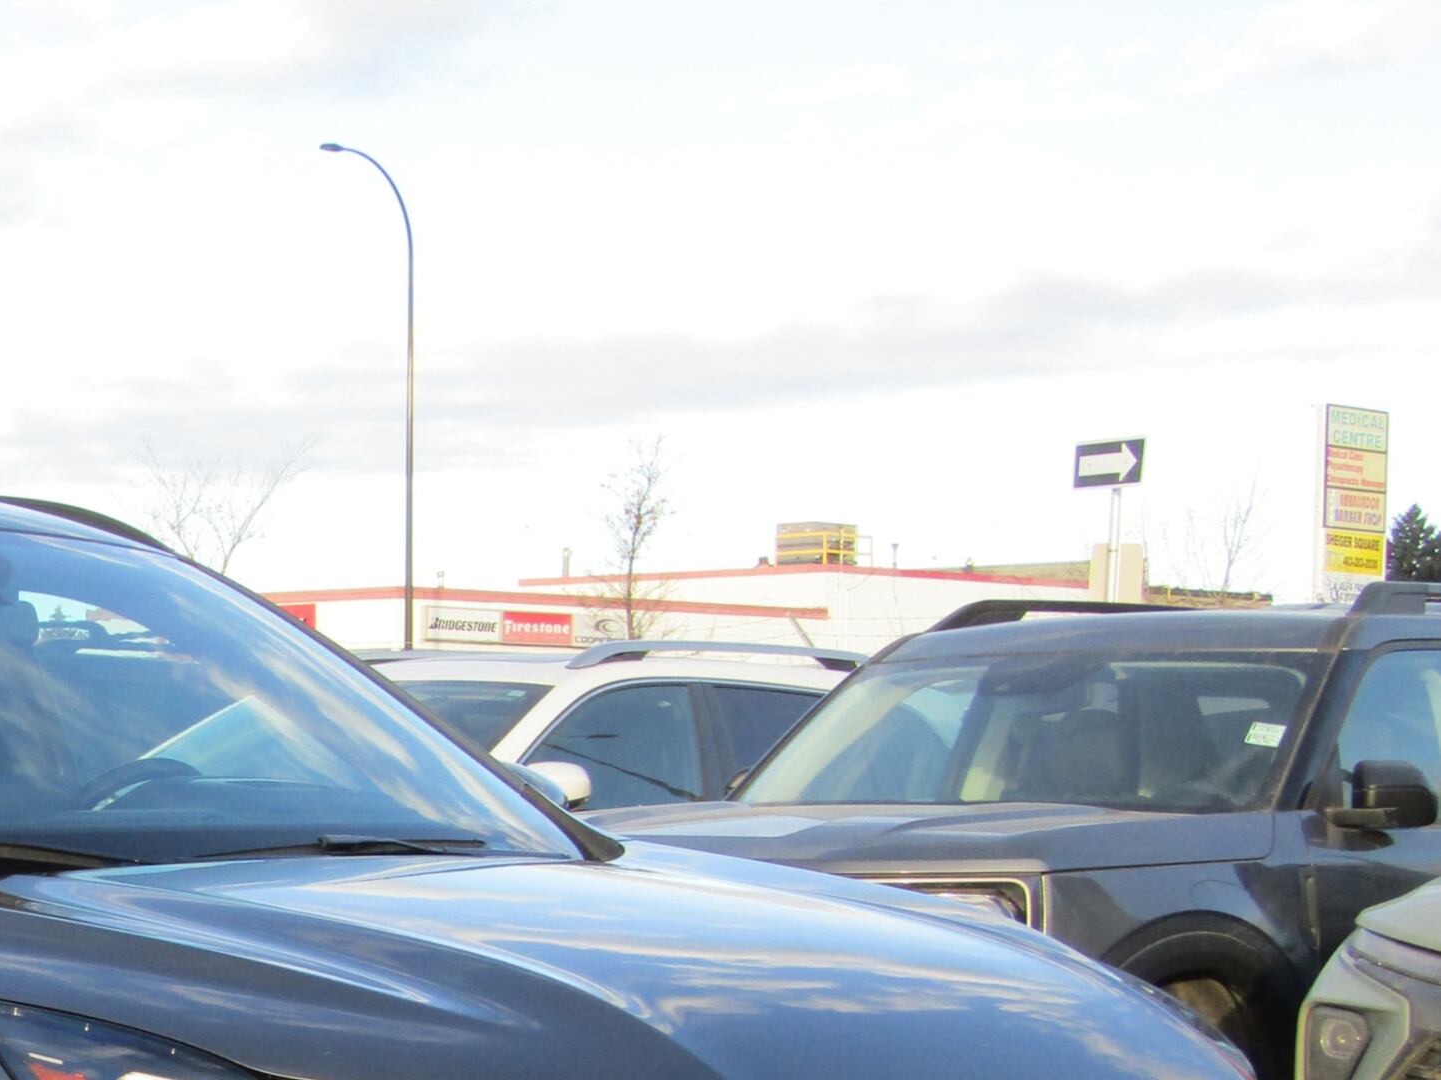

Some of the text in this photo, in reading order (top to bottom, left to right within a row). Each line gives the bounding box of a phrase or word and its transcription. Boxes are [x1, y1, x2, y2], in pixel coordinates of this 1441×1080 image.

[1330, 409, 1384, 430] MEDICAL
[1333, 429, 1382, 449] CENTRE
[1354, 537, 1380, 553] SQUARE
[428, 616, 498, 634] BRIDGESTONE
[503, 619, 570, 635] Firestone
